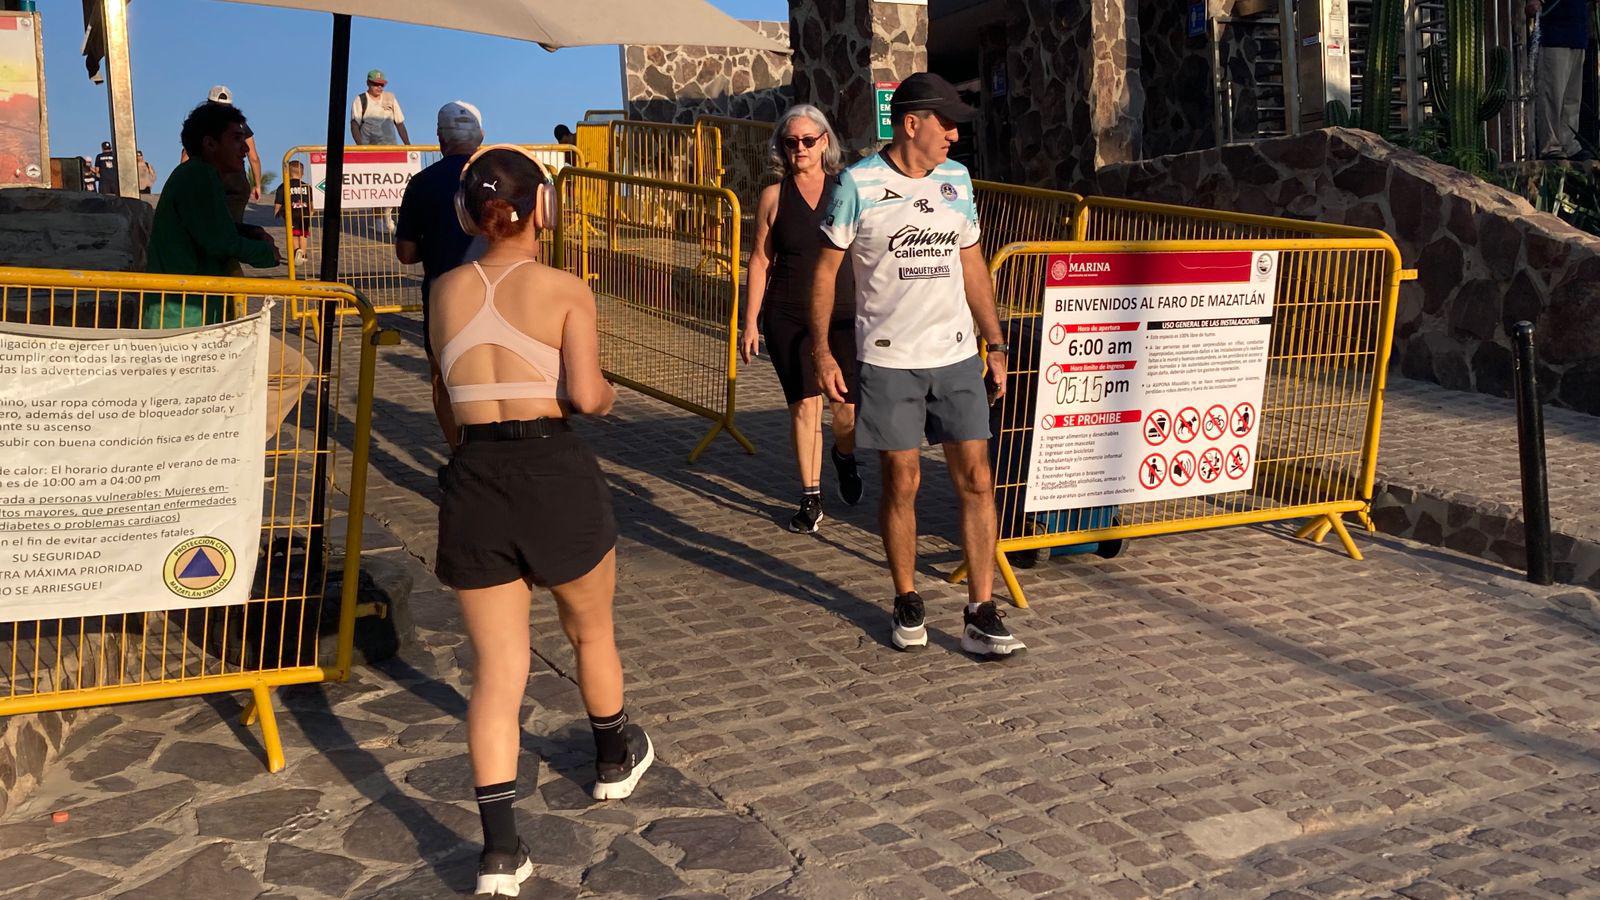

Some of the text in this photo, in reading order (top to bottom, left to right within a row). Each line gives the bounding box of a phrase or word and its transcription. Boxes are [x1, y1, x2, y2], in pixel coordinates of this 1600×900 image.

[342, 172, 413, 185] ENTRADA
[343, 187, 405, 200] ENTRANC
[887, 224, 960, 252] Caliente
[894, 247, 953, 259] caliente.m
[1069, 262, 1111, 273] MARINA
[1055, 290, 1266, 312] BIENVENIDOS AL FARO DE MAZATLÁN
[1098, 324, 1121, 332] apertura
[1162, 321, 1175, 329] USO
[1175, 320, 1200, 328] GENERAL
[1209, 319, 1220, 327] LAS
[1220, 318, 1260, 326] INSTALACIONES
[50, 340, 65, 350] de
[69, 341, 110, 352] ejercer
[113, 343, 128, 351] un
[130, 341, 158, 351] buen
[160, 342, 189, 353] juicio
[192, 343, 199, 351] y
[1068, 338, 1103, 356] 6:00
[1107, 340, 1132, 354] am
[0, 352, 46, 363] cumplir
[49, 355, 71, 363] con
[74, 354, 107, 364] todas
[110, 354, 127, 364] las
[130, 354, 162, 365] reglas
[164, 354, 178, 363] de
[181, 352, 218, 364] ingreso
[228, 351, 242, 360] in-
[21, 365, 37, 375] las
[41, 366, 117, 376] advertencias
[120, 366, 168, 376] verbales
[170, 367, 177, 377] y
[179, 364, 220, 375] escritas.
[1056, 375, 1103, 405] 05:15
[1104, 379, 1130, 398] pm
[31, 399, 57, 407] usar
[61, 399, 88, 408] ropa
[91, 397, 138, 407] cómoda
[141, 399, 147, 408] y
[150, 397, 181, 408] ligera,
[184, 394, 217, 405] zapato
[219, 392, 235, 401] de-
[25, 410, 73, 420] además
[76, 410, 95, 419] del
[98, 411, 118, 419] uso
[121, 409, 136, 418] de
[139, 407, 199, 419] bloqueador
[201, 405, 226, 415] solar,
[228, 405, 235, 413] y
[1063, 412, 1122, 426] SE PROHIBE
[0, 422, 92, 432] nte su ascenso
[0, 437, 29, 447] subir
[33, 439, 55, 447] con
[59, 437, 96, 447] buena
[100, 436, 153, 447] condición
[184, 434, 195, 442] es
[197, 432, 210, 440] de
[212, 430, 240, 440] entre
[14, 465, 47, 475] calor:
[51, 465, 61, 474] El
[65, 464, 108, 474] horario
[110, 463, 154, 473] durante
[156, 461, 165, 470] el
[168, 460, 203, 470] verano
[205, 457, 218, 466] de
[220, 457, 241, 465] ma-
[6, 480, 20, 488] es
[23, 478, 39, 488] de
[43, 477, 76, 487] 10:00
[78, 478, 97, 486] am
[110, 475, 141, 485] 04:00
[144, 474, 161, 484] pm
[28, 496, 35, 504] a
[39, 495, 92, 505] personas
[96, 489, 161, 502] vulnerables:
[164, 486, 206, 497] Mujeres
[0, 496, 237, 518] tos mayores, que presentan enfermedades
[0, 521, 50, 530] diabetes
[53, 521, 61, 529] o
[64, 518, 125, 530] problemas
[12, 537, 23, 546] el
[27, 536, 42, 546] fin
[46, 535, 60, 546] de
[64, 535, 97, 545] evitar
[100, 531, 158, 543] accidentes
[161, 527, 195, 538] fatales
[215, 542, 229, 555] CIVIL
[12, 550, 101, 563] SU SEGURIDAD
[24, 567, 77, 578] MÁXIMA
[80, 563, 143, 575] PRIORIDAD
[15, 585, 29, 595] SE
[32, 581, 103, 594] ARRIESGUE!
[202, 577, 228, 596] SINALOA
